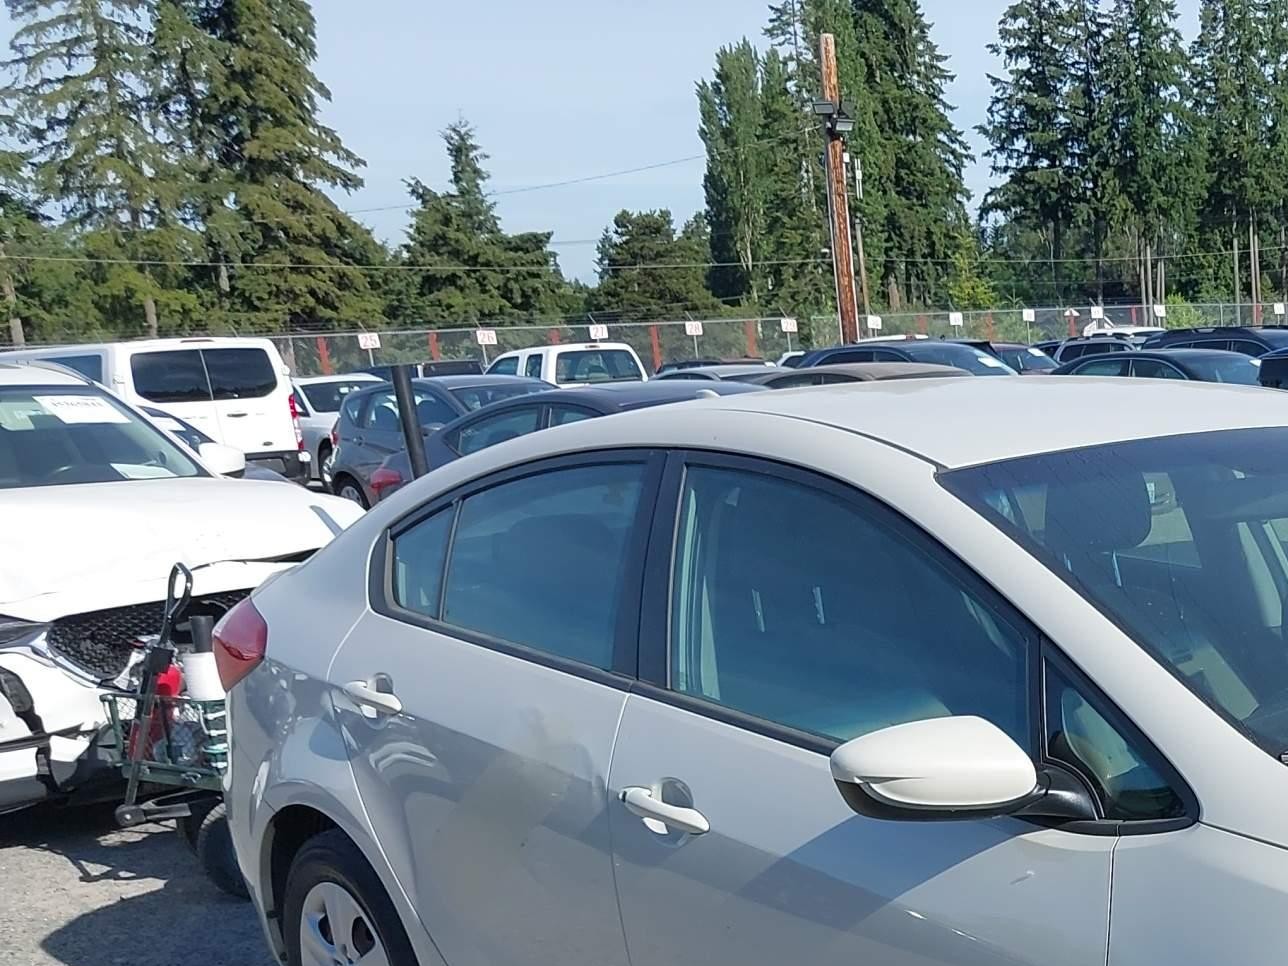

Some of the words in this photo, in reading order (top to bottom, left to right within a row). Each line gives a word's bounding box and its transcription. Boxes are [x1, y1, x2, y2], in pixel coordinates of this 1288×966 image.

[592, 326, 605, 337] 27
[361, 335, 378, 347] 25
[480, 332, 495, 343] 26
